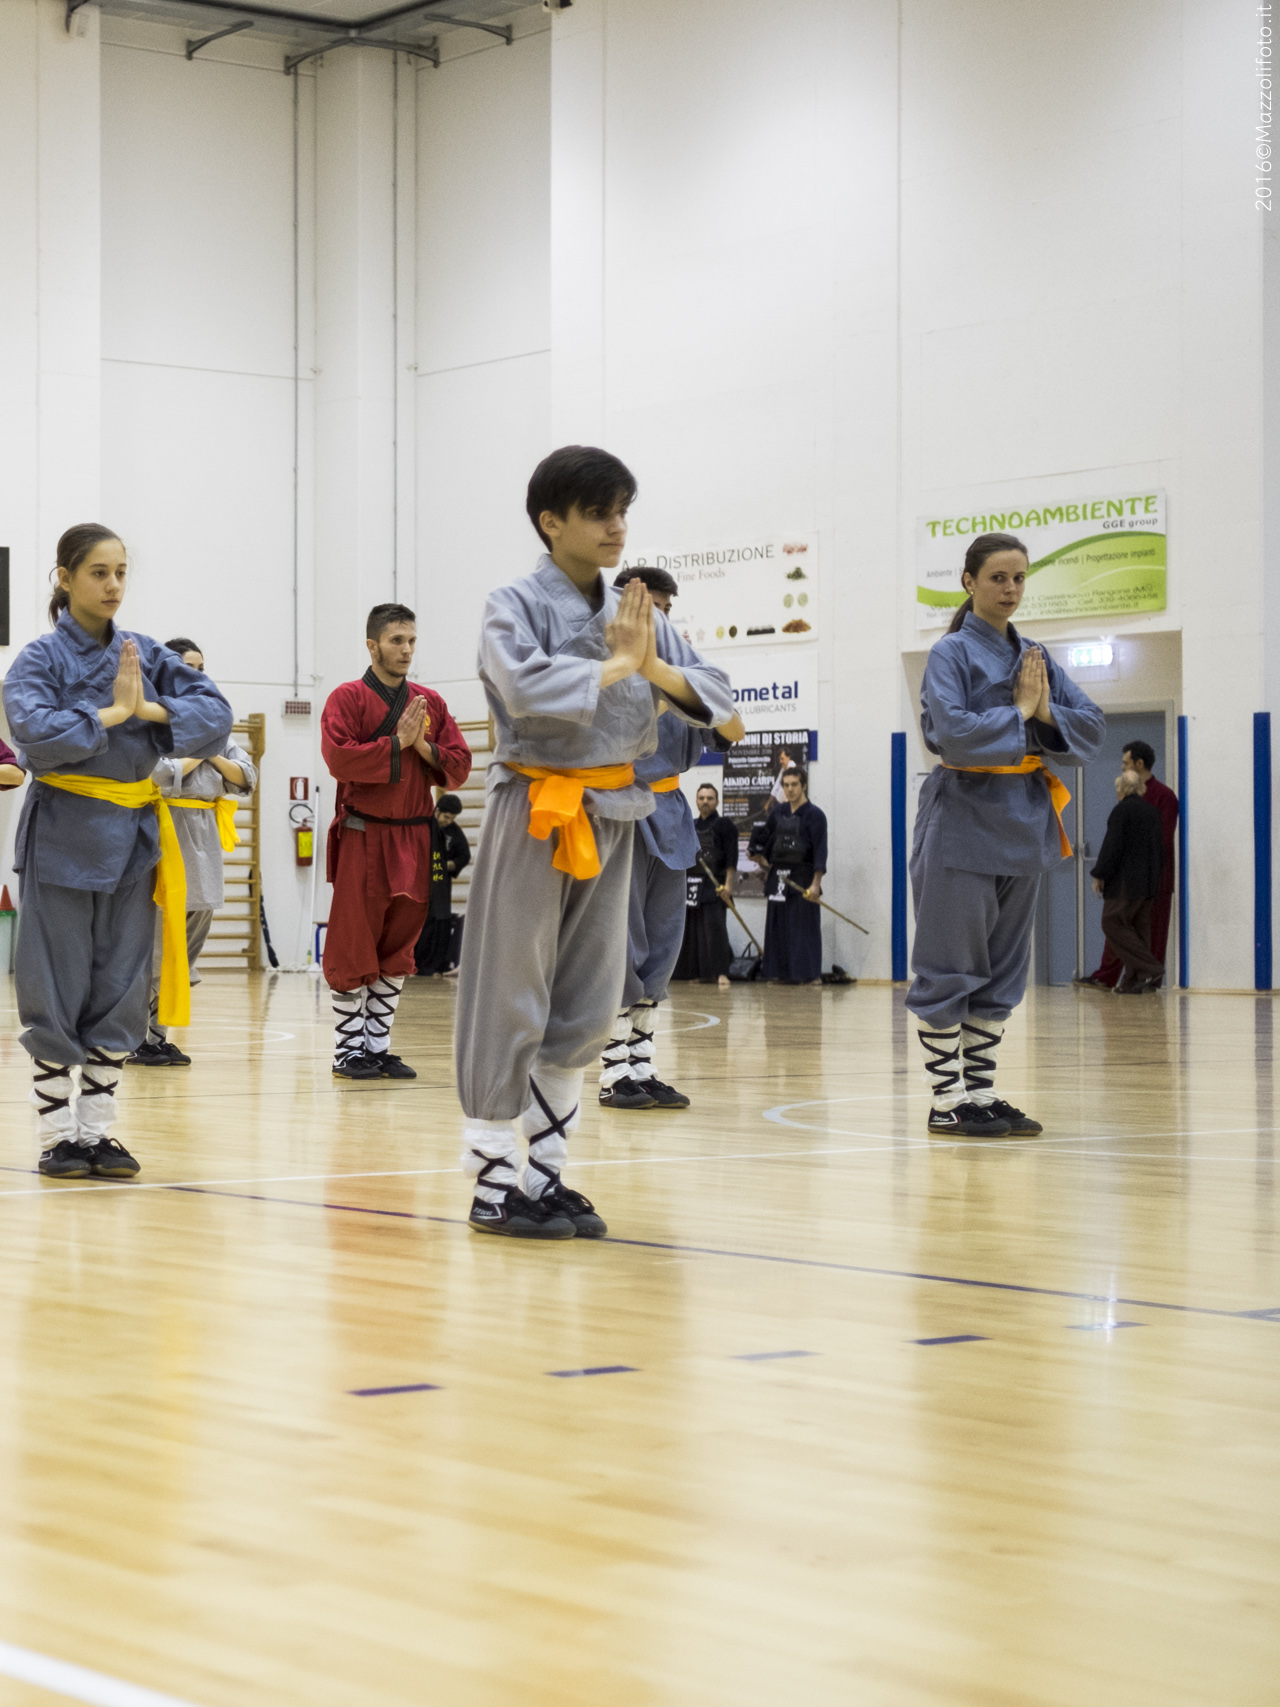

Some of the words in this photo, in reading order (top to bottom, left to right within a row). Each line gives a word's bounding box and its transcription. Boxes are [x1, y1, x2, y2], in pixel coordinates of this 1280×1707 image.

[926, 494, 1158, 538] TECHNOAMBIENTE
[1102, 520, 1126, 529] GGE
[1128, 518, 1158, 528] group
[1086, 551, 1129, 564] Progettazione
[677, 571, 696, 582] Fine
[698, 568, 726, 579] Foods
[732, 680, 798, 702] ometal
[745, 703, 797, 715] LUBRICANTS
[762, 732, 772, 745] DI
[774, 730, 808, 745] STORIA
[723, 776, 750, 787] AIKIDO
[752, 775, 775, 786] CARPI
